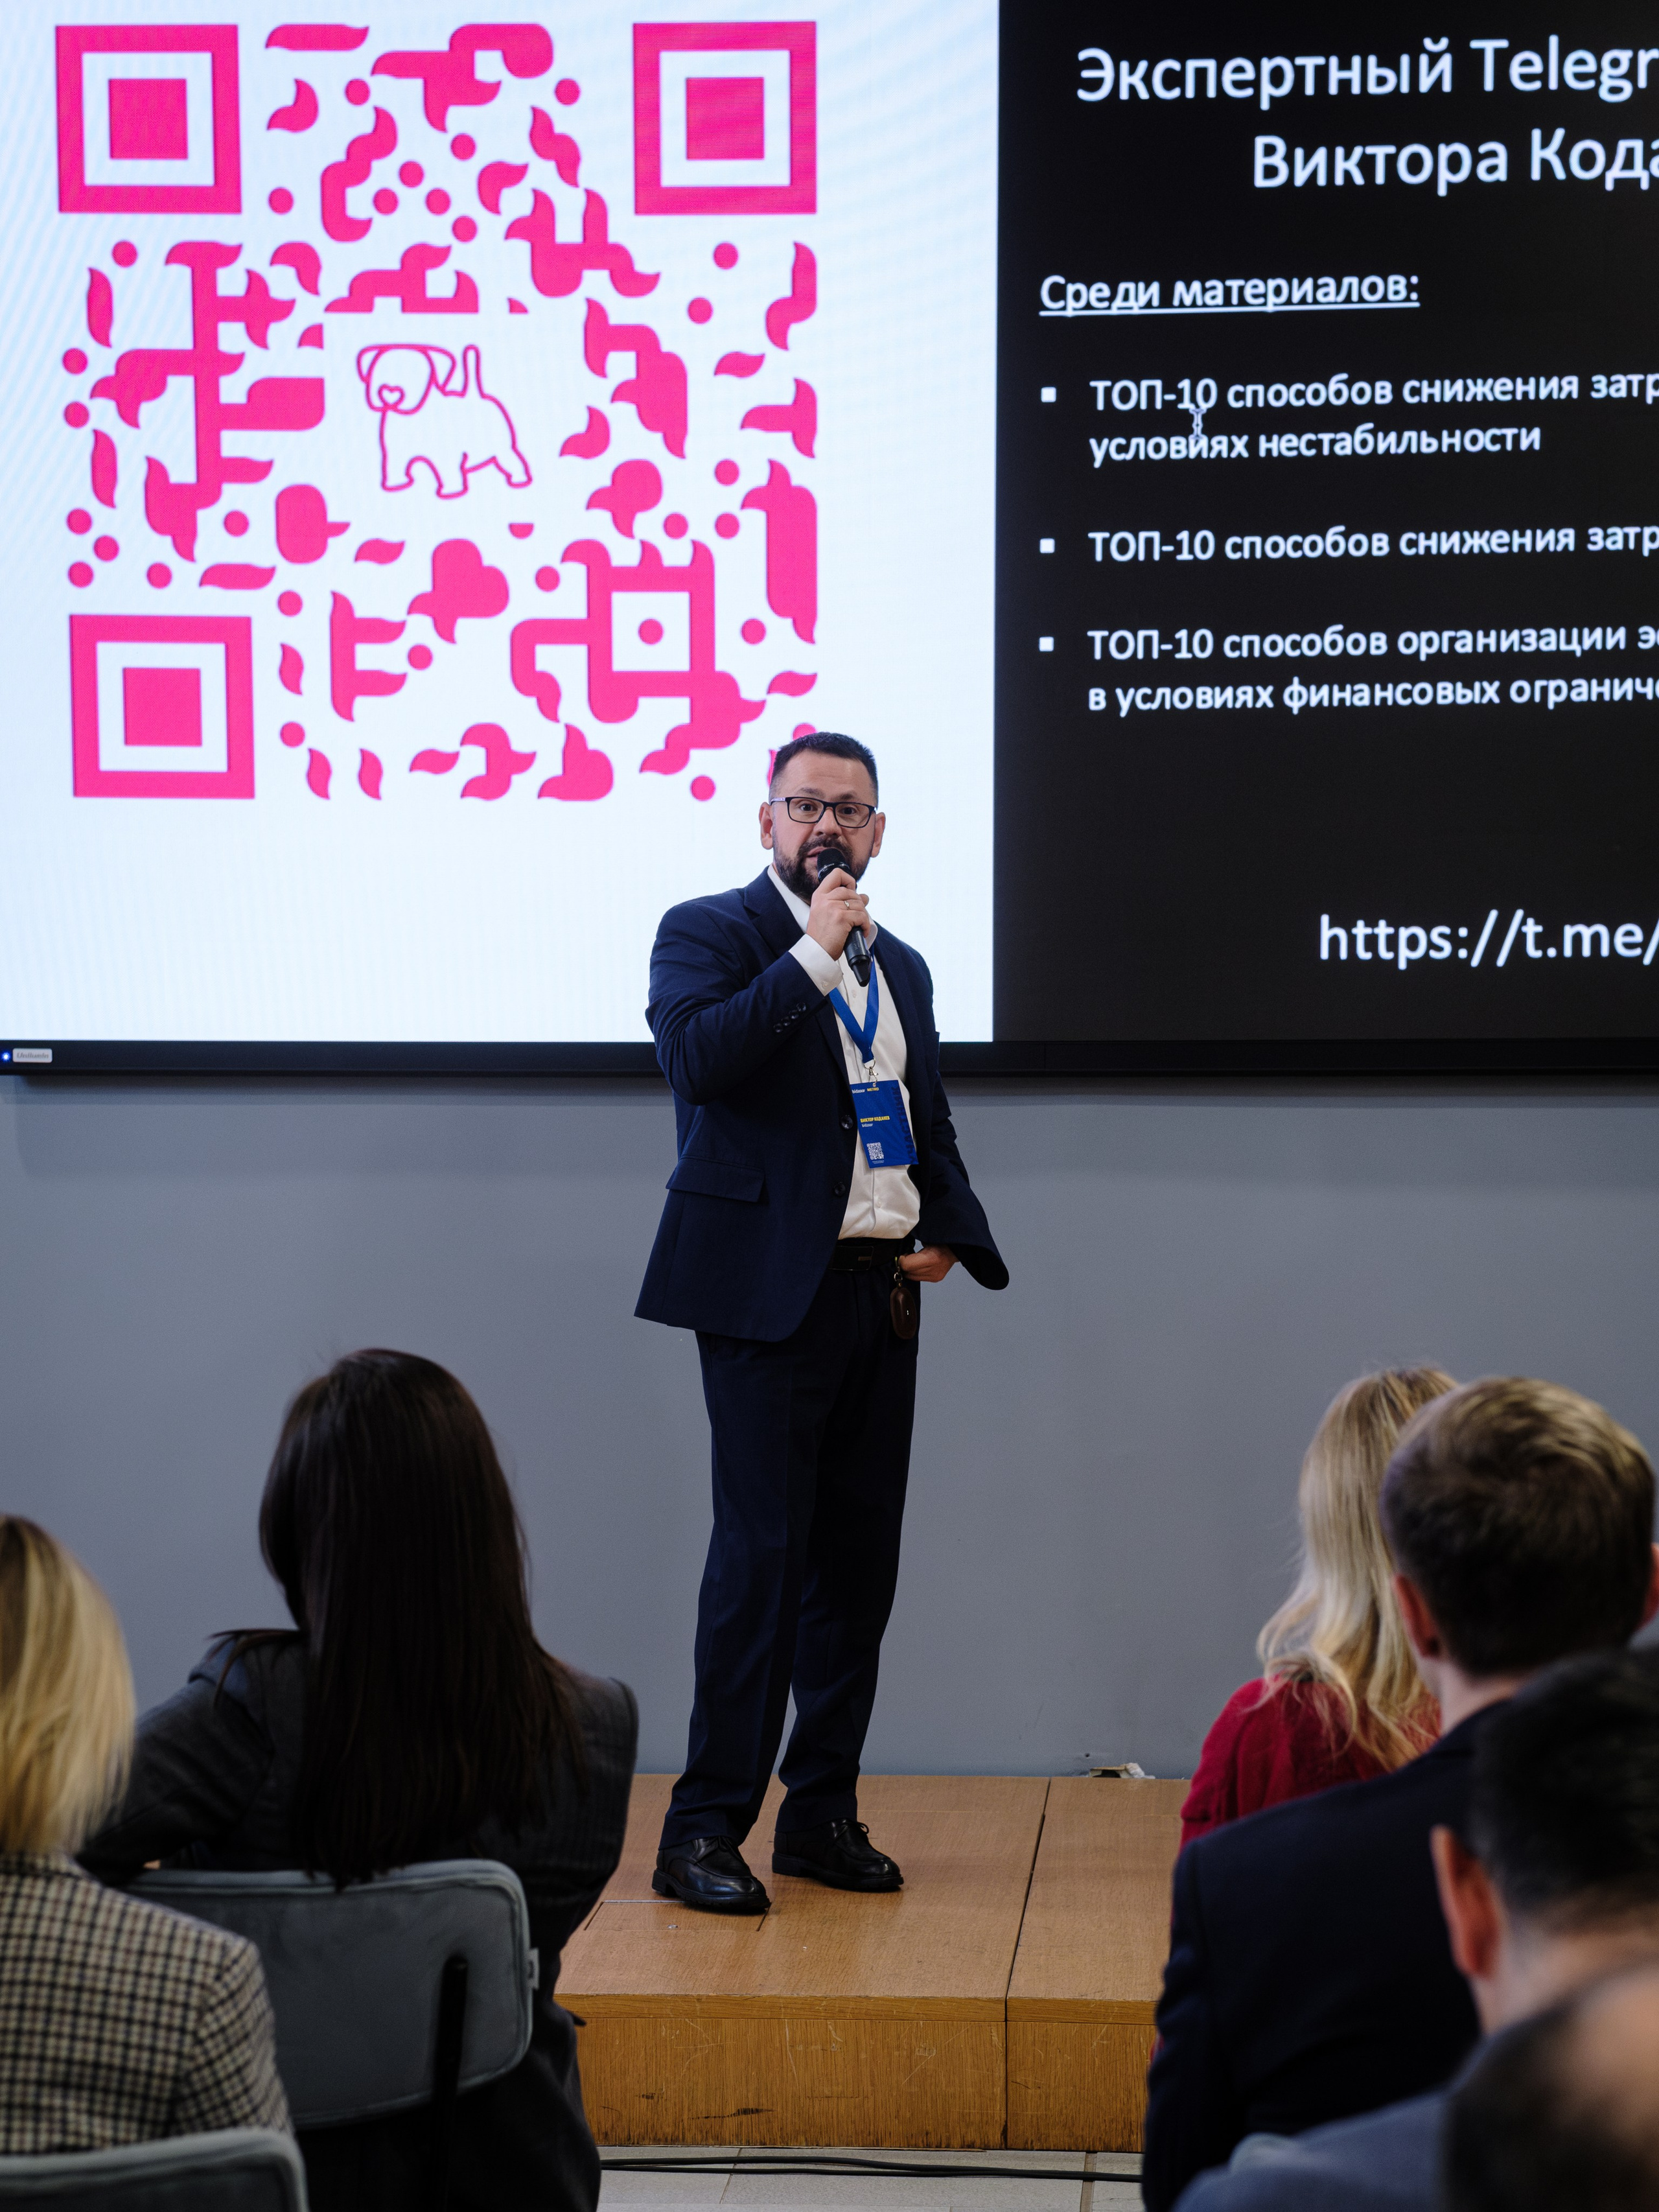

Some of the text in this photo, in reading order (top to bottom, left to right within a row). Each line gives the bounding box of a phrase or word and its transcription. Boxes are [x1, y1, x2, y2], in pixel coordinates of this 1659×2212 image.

[1076, 34, 1659, 111] Экспертный Telegr
[1253, 135, 1508, 196] Виктора
[1039, 274, 1419, 316] Среди материалов:
[1089, 378, 1217, 410] ТОП-10
[1227, 373, 1393, 408] способов
[1402, 375, 1579, 404] снижения
[1089, 422, 1541, 469] условиях нестабильности
[1087, 525, 1659, 562] ТОП-10 способов снижения затр
[1086, 623, 1659, 662] ТОП-10 способов организации э
[1088, 676, 1659, 718] в условиях финансовых огранич
